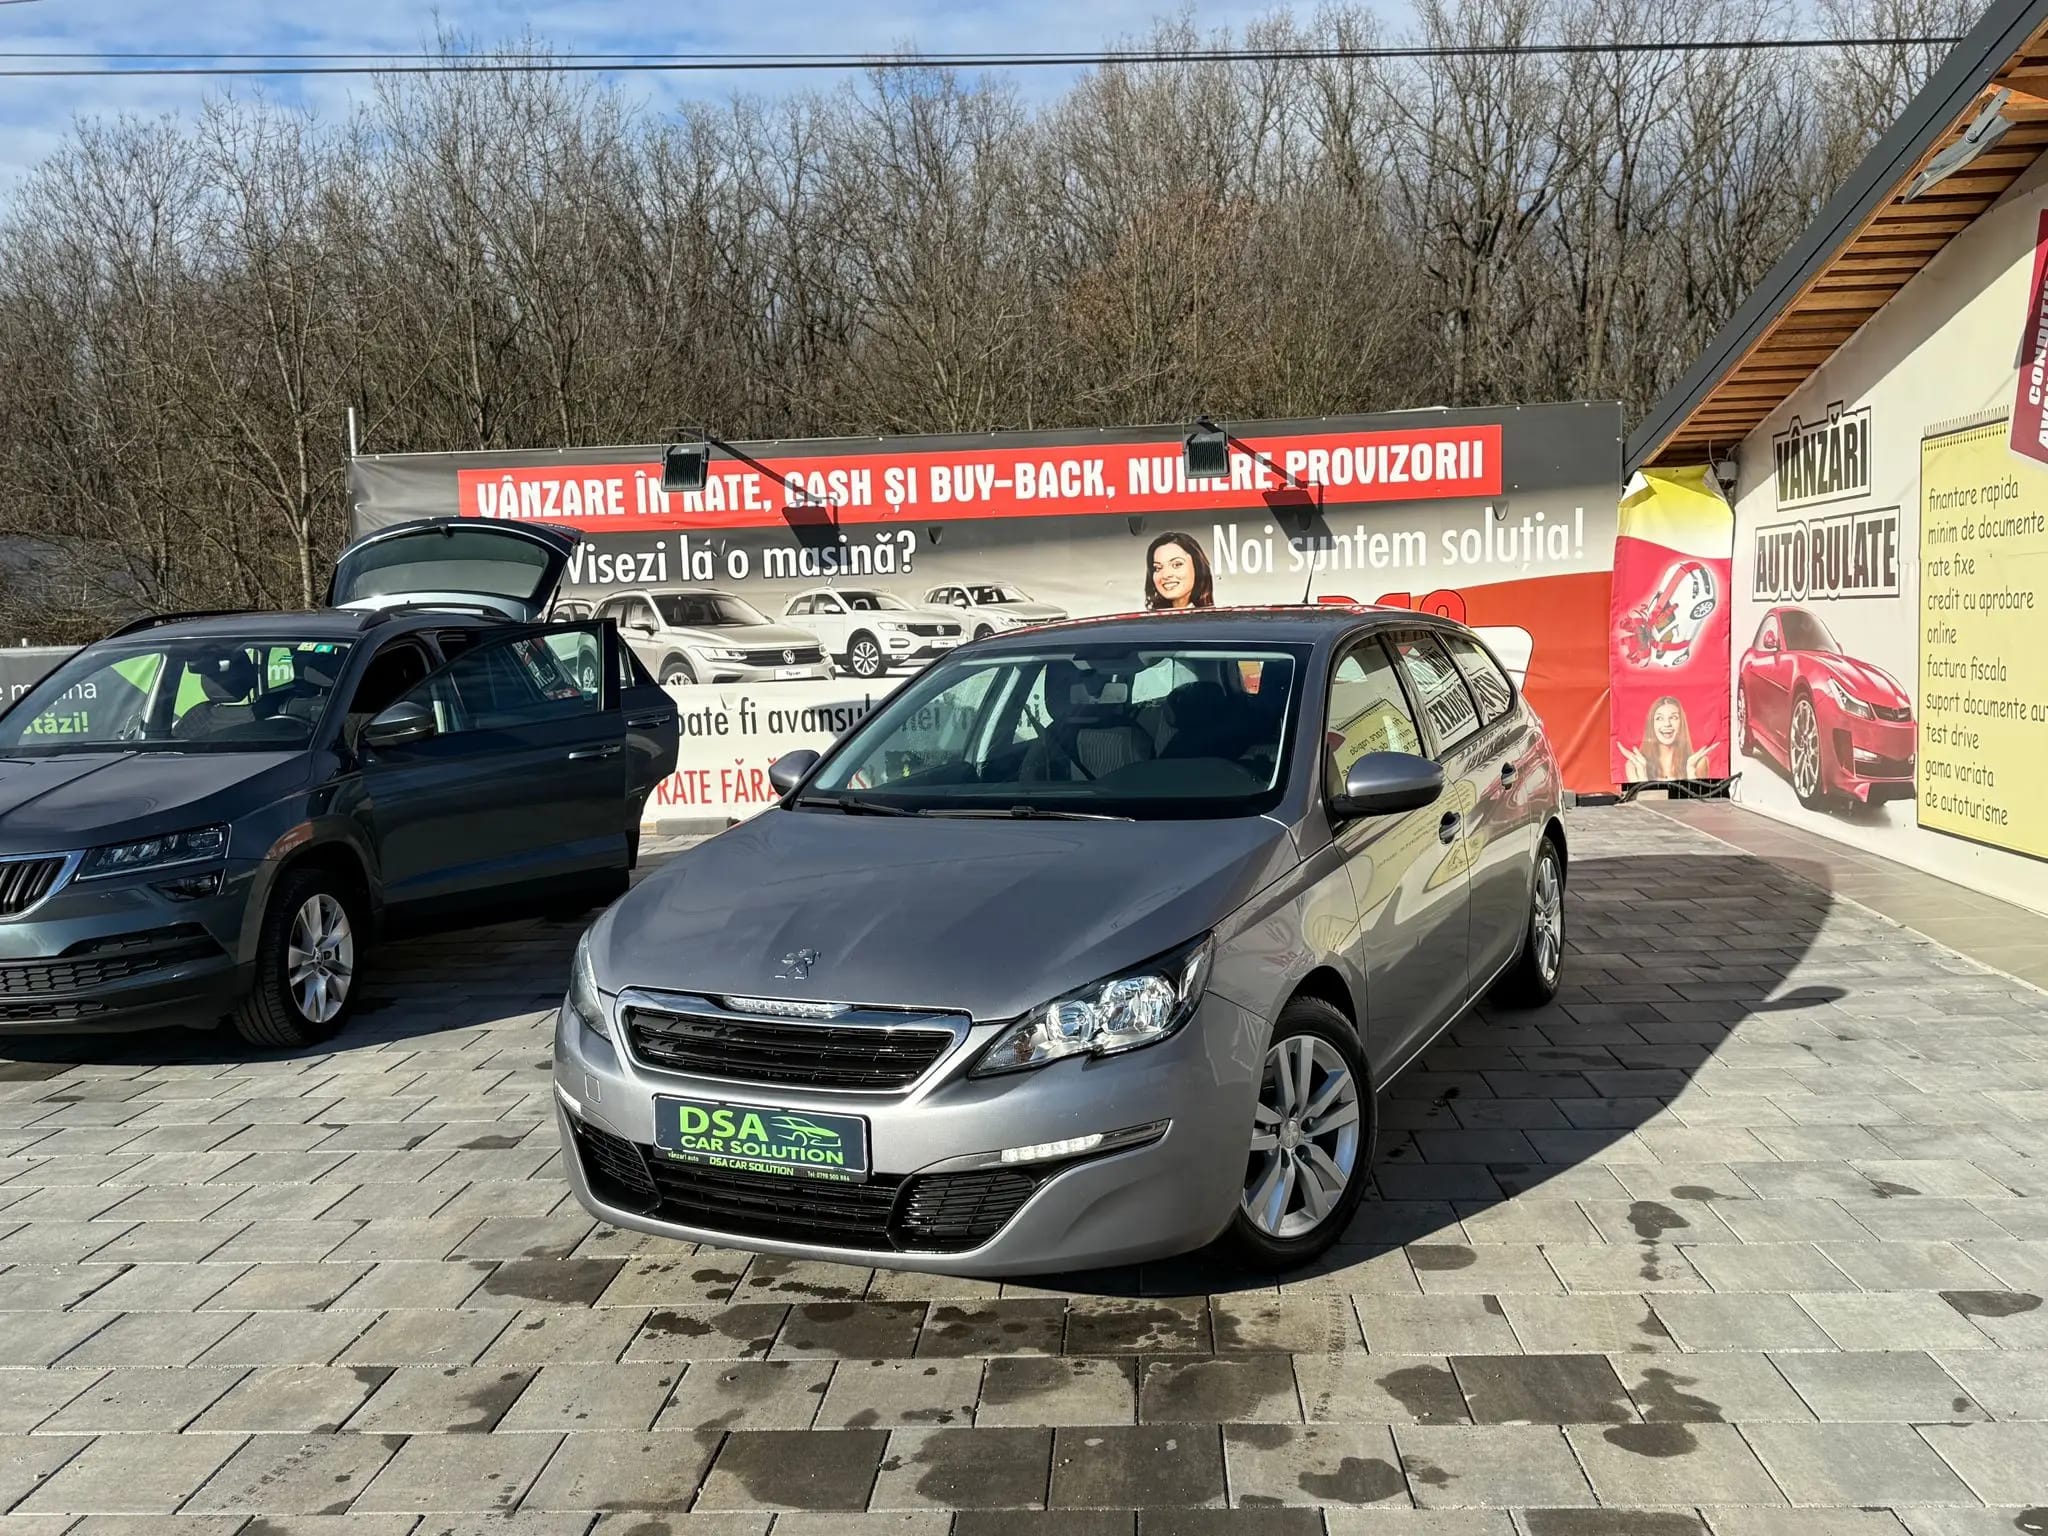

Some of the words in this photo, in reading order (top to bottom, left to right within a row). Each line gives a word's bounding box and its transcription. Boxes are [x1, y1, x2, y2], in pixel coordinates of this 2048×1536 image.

[1776, 412, 1867, 501] VÂNZĂRI
[476, 475, 625, 519] VÂNZARE
[784, 469, 872, 508] CASH
[884, 467, 917, 513] ȘI
[930, 459, 1116, 503] BUY-BACK,
[1286, 440, 1483, 487] PROVIZORII
[1929, 488, 1977, 512] finantare
[1981, 474, 2019, 510] rapida
[1213, 524, 1273, 574] Noi
[1287, 528, 1427, 575] suntem
[1443, 507, 1584, 572] soluția!
[1928, 521, 1958, 544] minim
[1961, 516, 1975, 541] de
[1978, 511, 2045, 539] documente
[567, 541, 667, 585] Visezi
[727, 550, 749, 579] o
[1755, 529, 1806, 593] AUTO
[1811, 518, 1896, 590] RULATE
[1928, 556, 1950, 577] rate
[1954, 553, 1975, 577] fixe
[1928, 586, 1960, 610] credit
[1963, 592, 1976, 610] cu
[1979, 585, 2034, 616] aprobare
[1927, 621, 1957, 644] online
[1927, 654, 1967, 678] factura
[1970, 656, 2007, 682] fiscala
[739, 697, 757, 735] fi
[1926, 692, 1960, 717] suport
[1963, 690, 2027, 720] documente
[2031, 704, 2048, 722] au
[1926, 722, 1948, 745] test
[1951, 723, 1980, 749] drive
[1925, 759, 1951, 781] gama
[1955, 762, 1994, 787] variata
[1926, 786, 1938, 808] de
[1941, 796, 2009, 826] autoturisme
[679, 1105, 769, 1142] DSA
[680, 1135, 724, 1152] CAR
[730, 1140, 844, 1166] SOLUTION
[709, 1156, 729, 1168] DSA
[729, 1159, 748, 1170] CAR
[748, 1162, 794, 1176] SOLUTION
